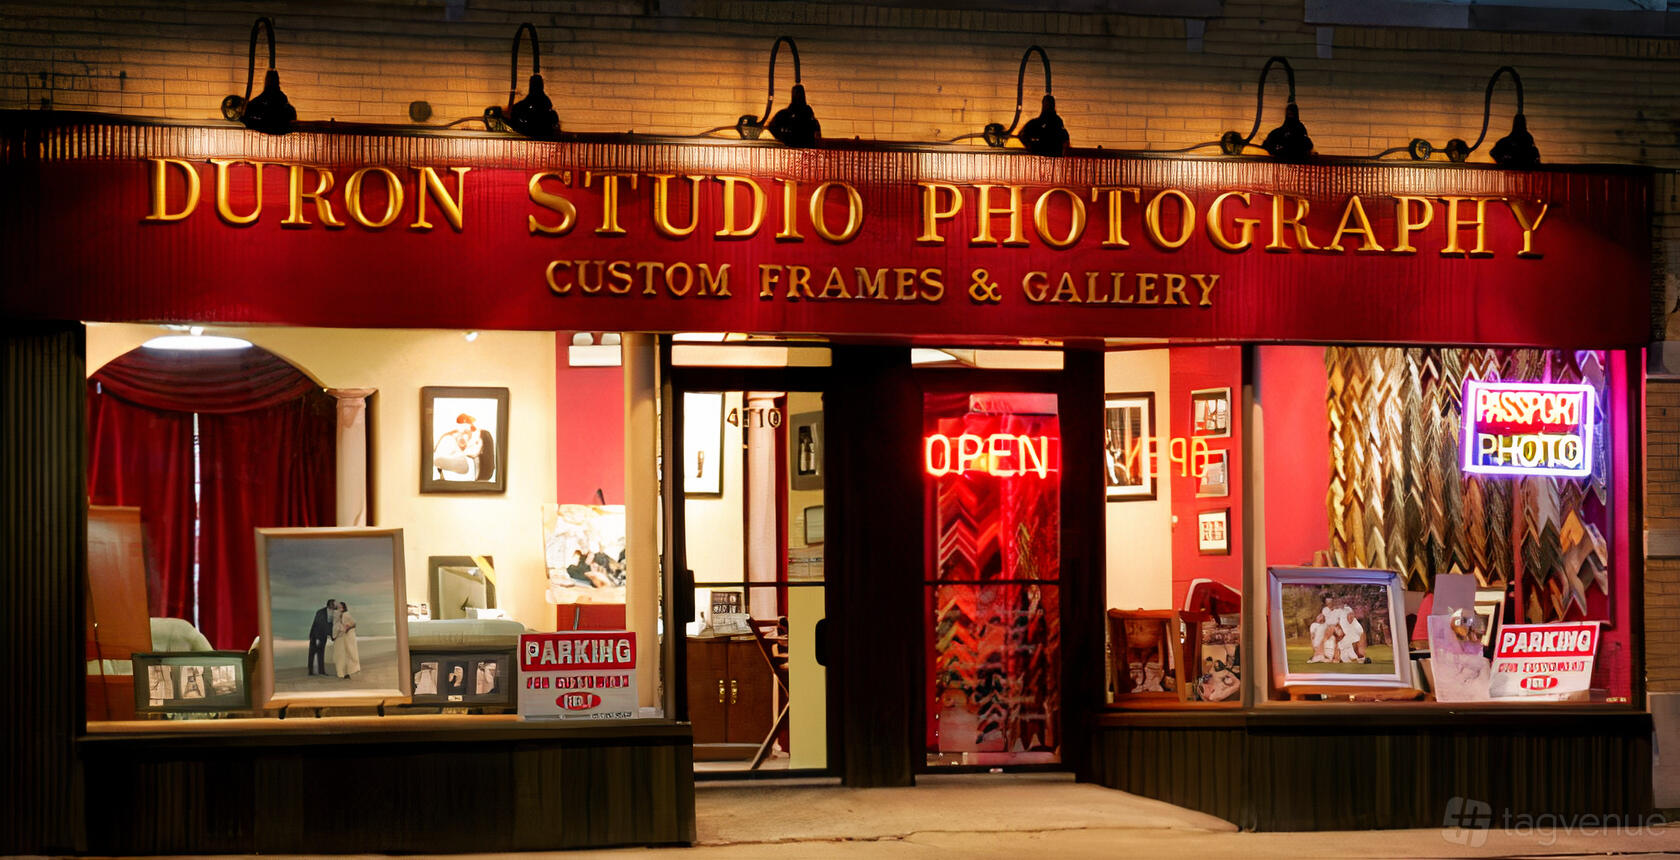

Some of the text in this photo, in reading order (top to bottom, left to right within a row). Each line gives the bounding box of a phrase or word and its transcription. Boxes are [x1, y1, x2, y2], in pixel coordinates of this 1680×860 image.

[145, 157, 1548, 258] DURON STUDIO PHOTOGRAPHY
[546, 259, 1221, 307] CUSTOM FRAMES & GALLERY
[1476, 389, 1583, 425] PASSPORT
[924, 433, 1049, 479] OPEN
[1478, 433, 1583, 468] PHOTO
[525, 639, 632, 665] PARKING
[1501, 630, 1591, 653] PARKING
